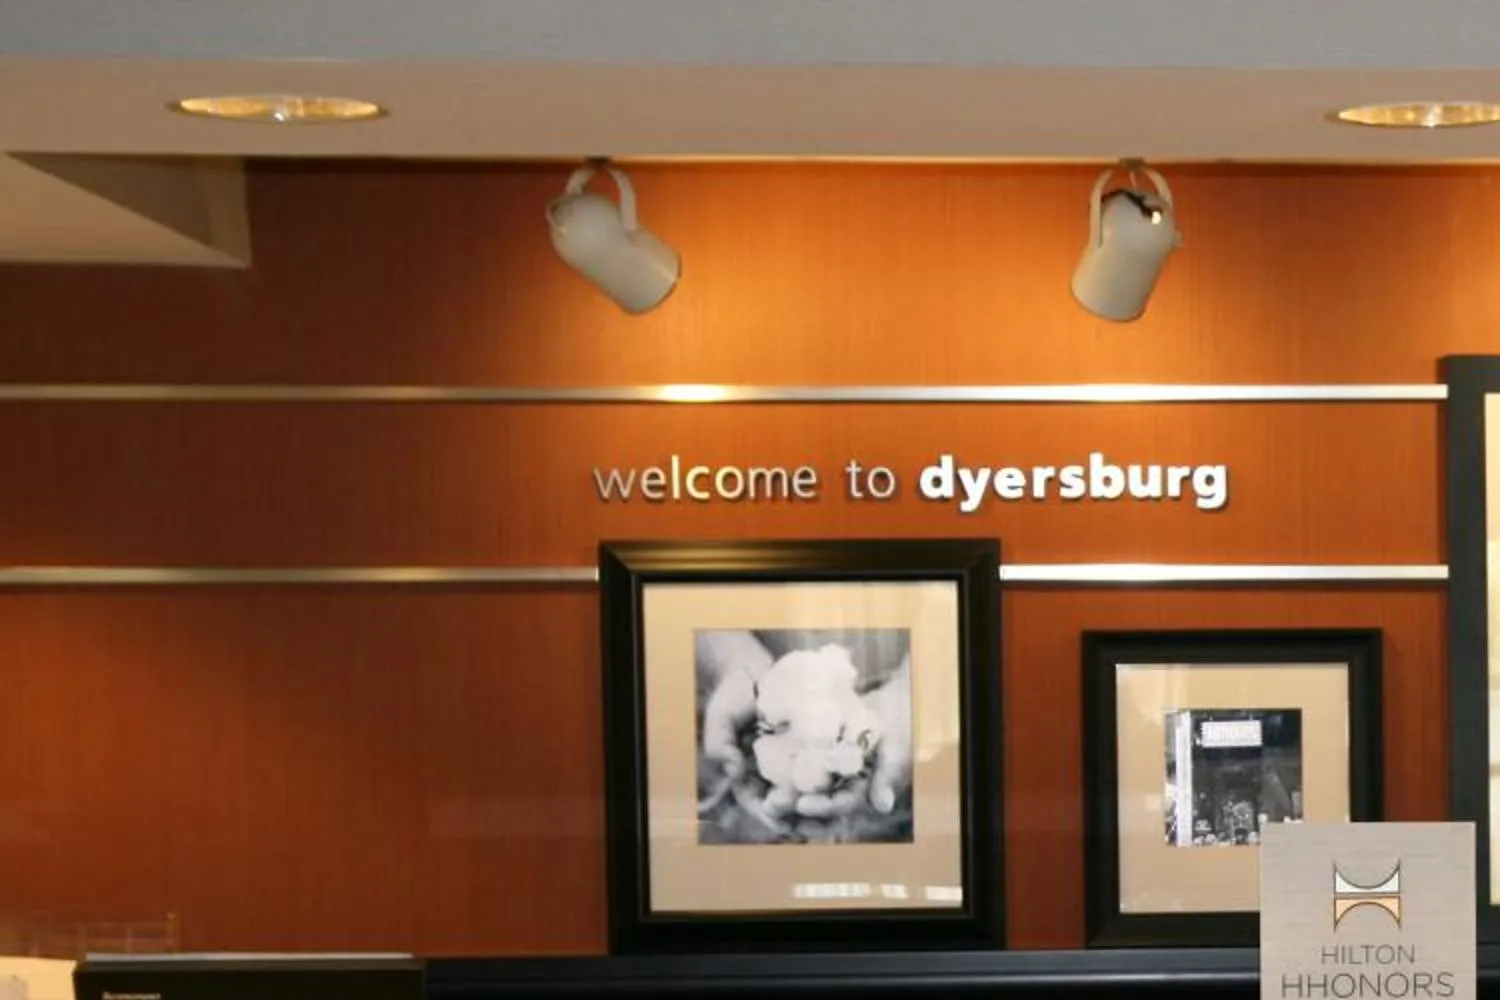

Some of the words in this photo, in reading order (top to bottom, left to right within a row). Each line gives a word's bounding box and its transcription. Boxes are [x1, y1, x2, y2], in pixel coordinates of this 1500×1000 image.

[593, 455, 817, 499] welcome
[846, 459, 896, 498] to
[919, 452, 1227, 512] dyersburg
[1321, 944, 1416, 965] HILTON
[1281, 972, 1455, 998] HHONORS
